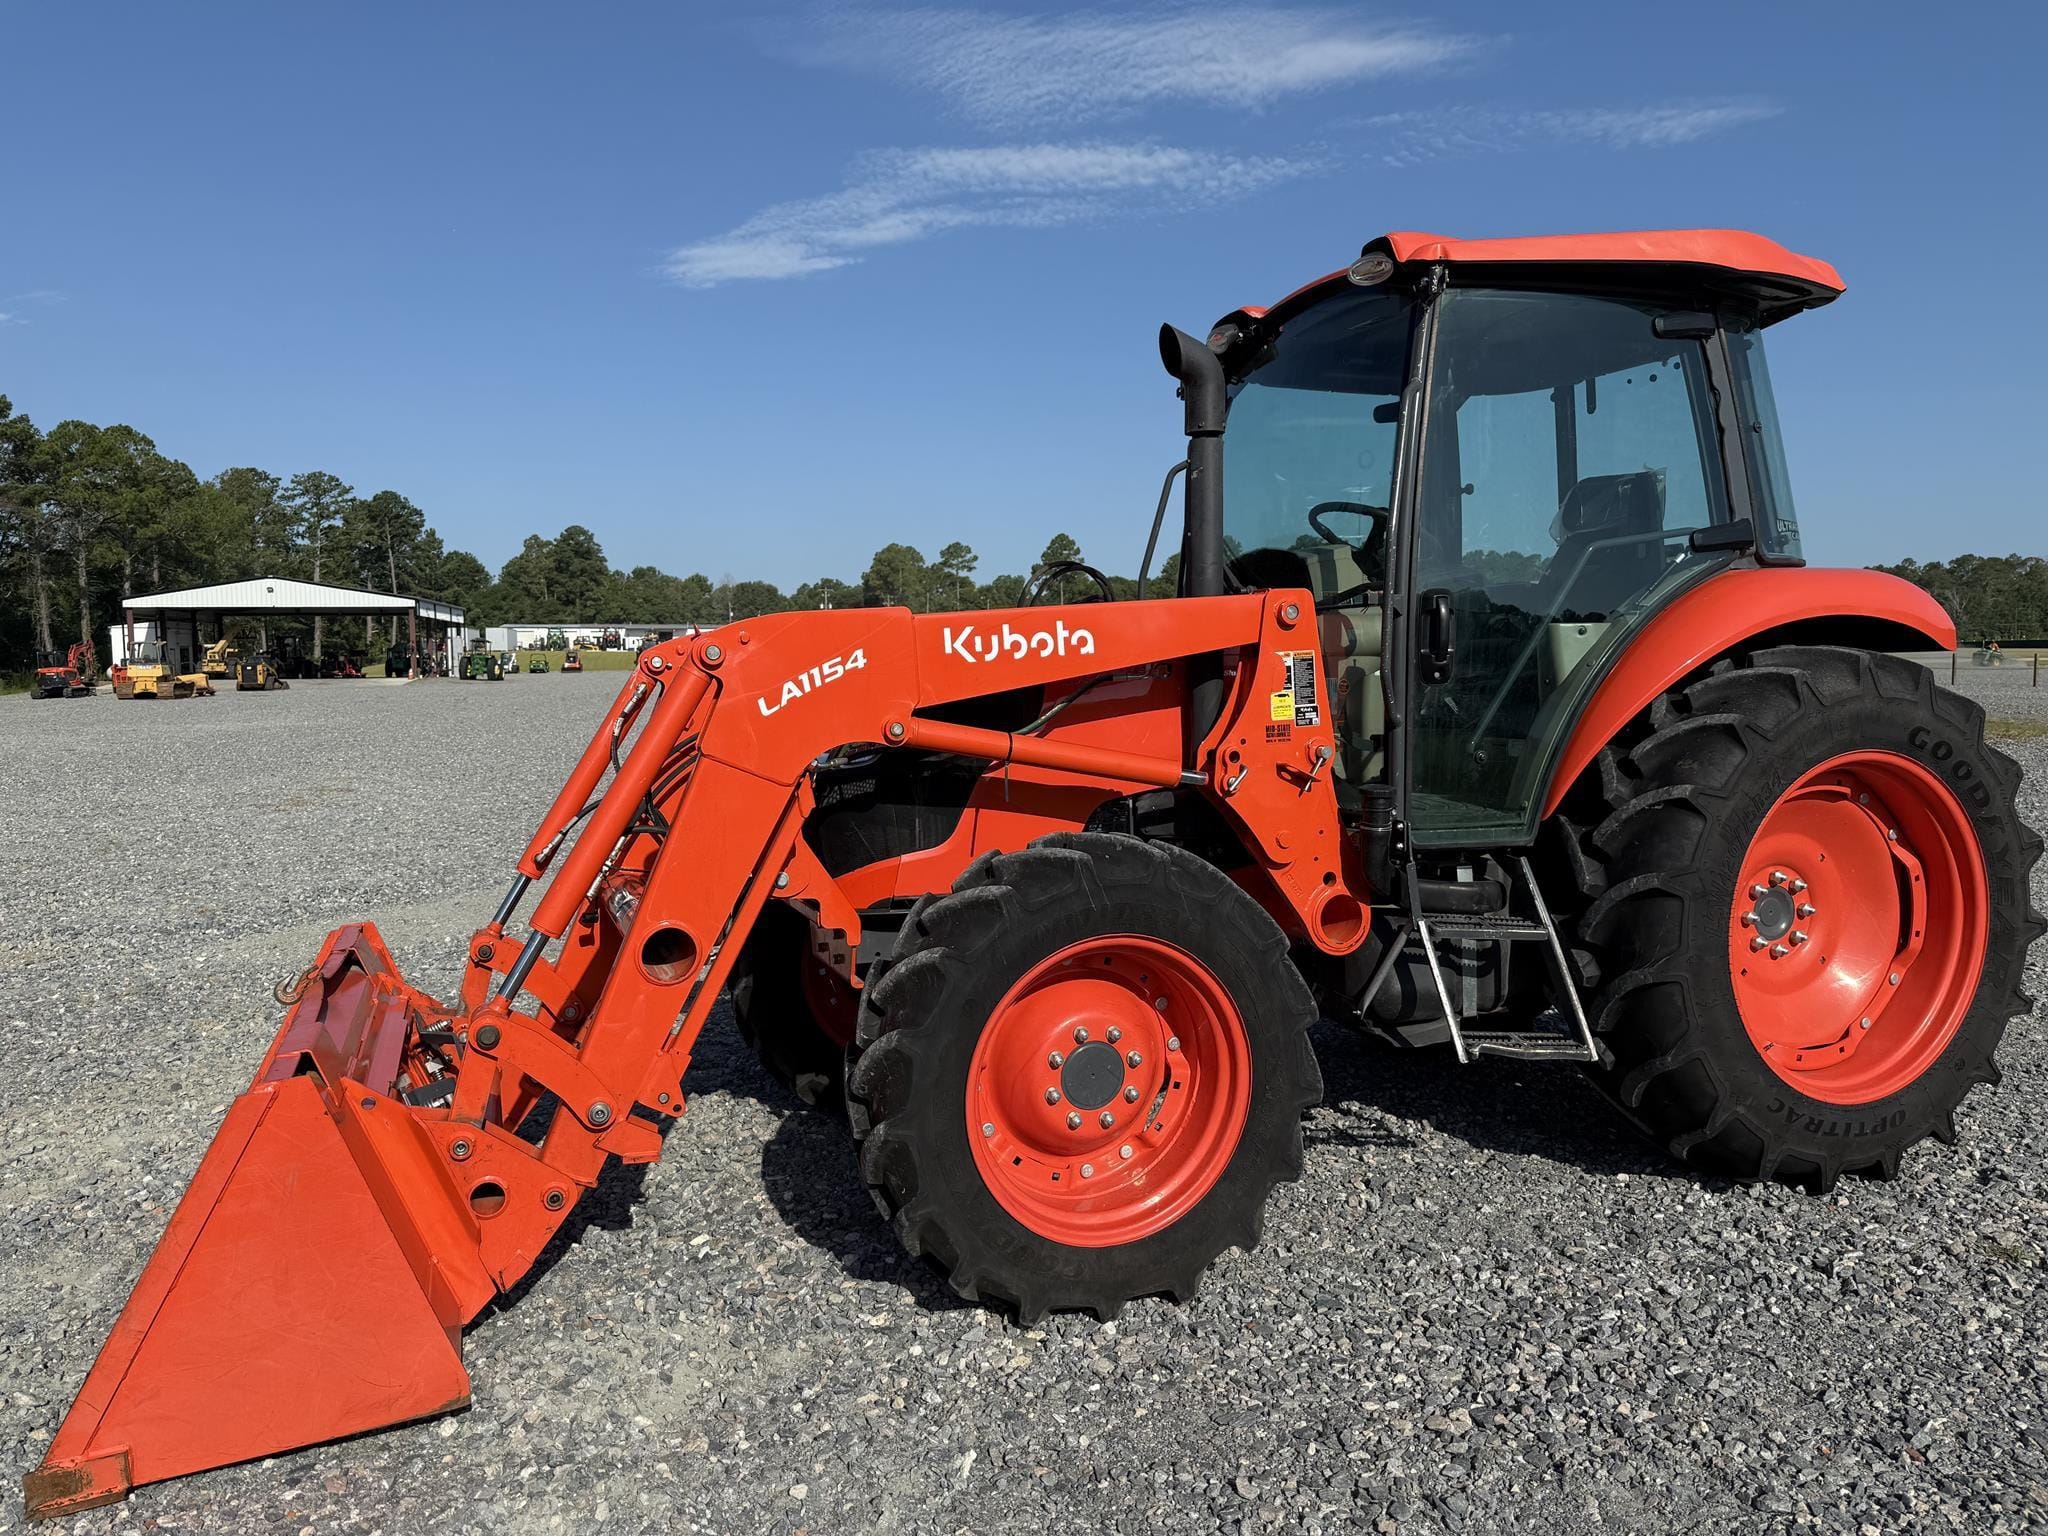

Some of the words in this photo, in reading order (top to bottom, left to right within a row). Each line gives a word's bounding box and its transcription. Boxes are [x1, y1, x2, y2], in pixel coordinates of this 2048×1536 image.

[944, 620, 1094, 663] Kubota
[757, 648, 867, 717] LA1154
[1766, 1097, 1906, 1138] OPTITRAC
